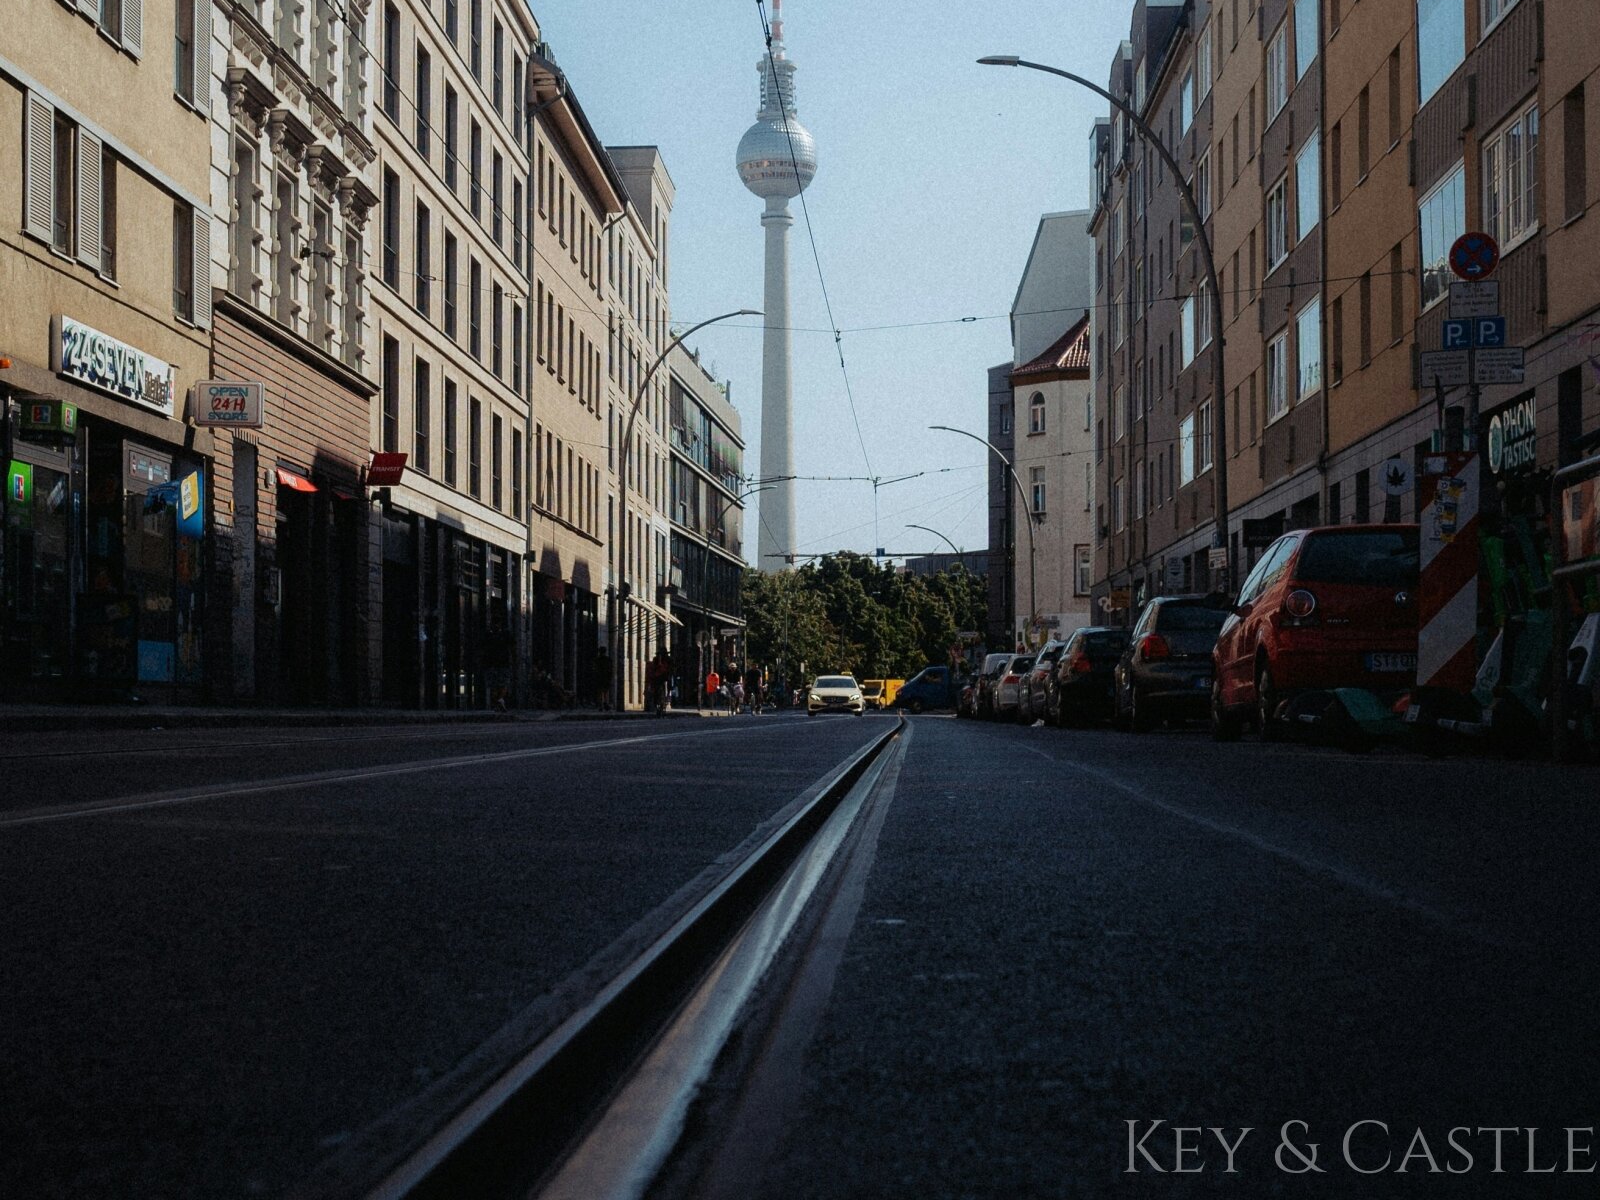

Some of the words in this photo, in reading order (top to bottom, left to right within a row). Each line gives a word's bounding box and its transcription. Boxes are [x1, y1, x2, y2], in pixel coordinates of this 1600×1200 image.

[1447, 323, 1462, 346] P
[1480, 321, 1496, 343] P
[208, 386, 249, 397] OPEN
[213, 397, 230, 410] 24
[233, 397, 244, 411] H
[207, 411, 249, 421] STORE
